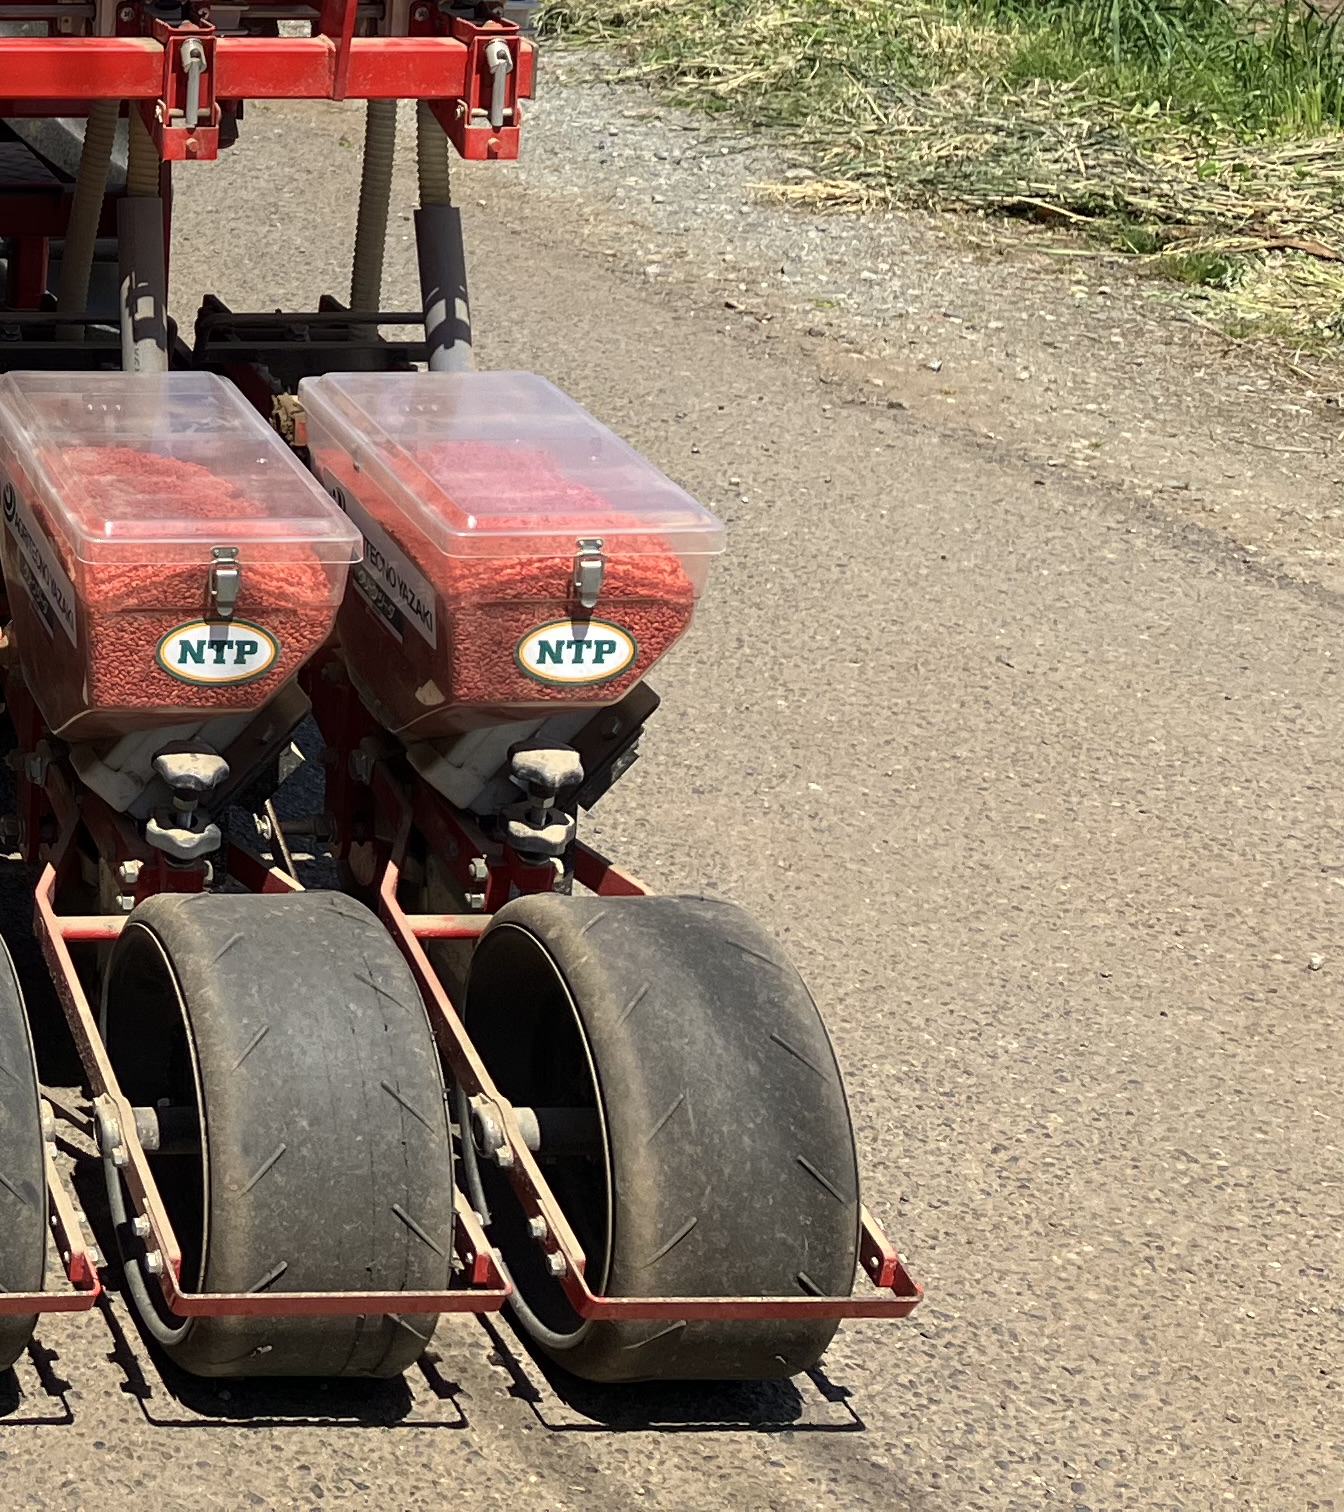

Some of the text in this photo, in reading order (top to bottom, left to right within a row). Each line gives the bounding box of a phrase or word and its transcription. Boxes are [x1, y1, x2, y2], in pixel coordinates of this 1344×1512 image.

[363, 535, 433, 633] TECNO YAZAKI
[178, 639, 259, 665] NTP
[536, 639, 617, 665] NTP
